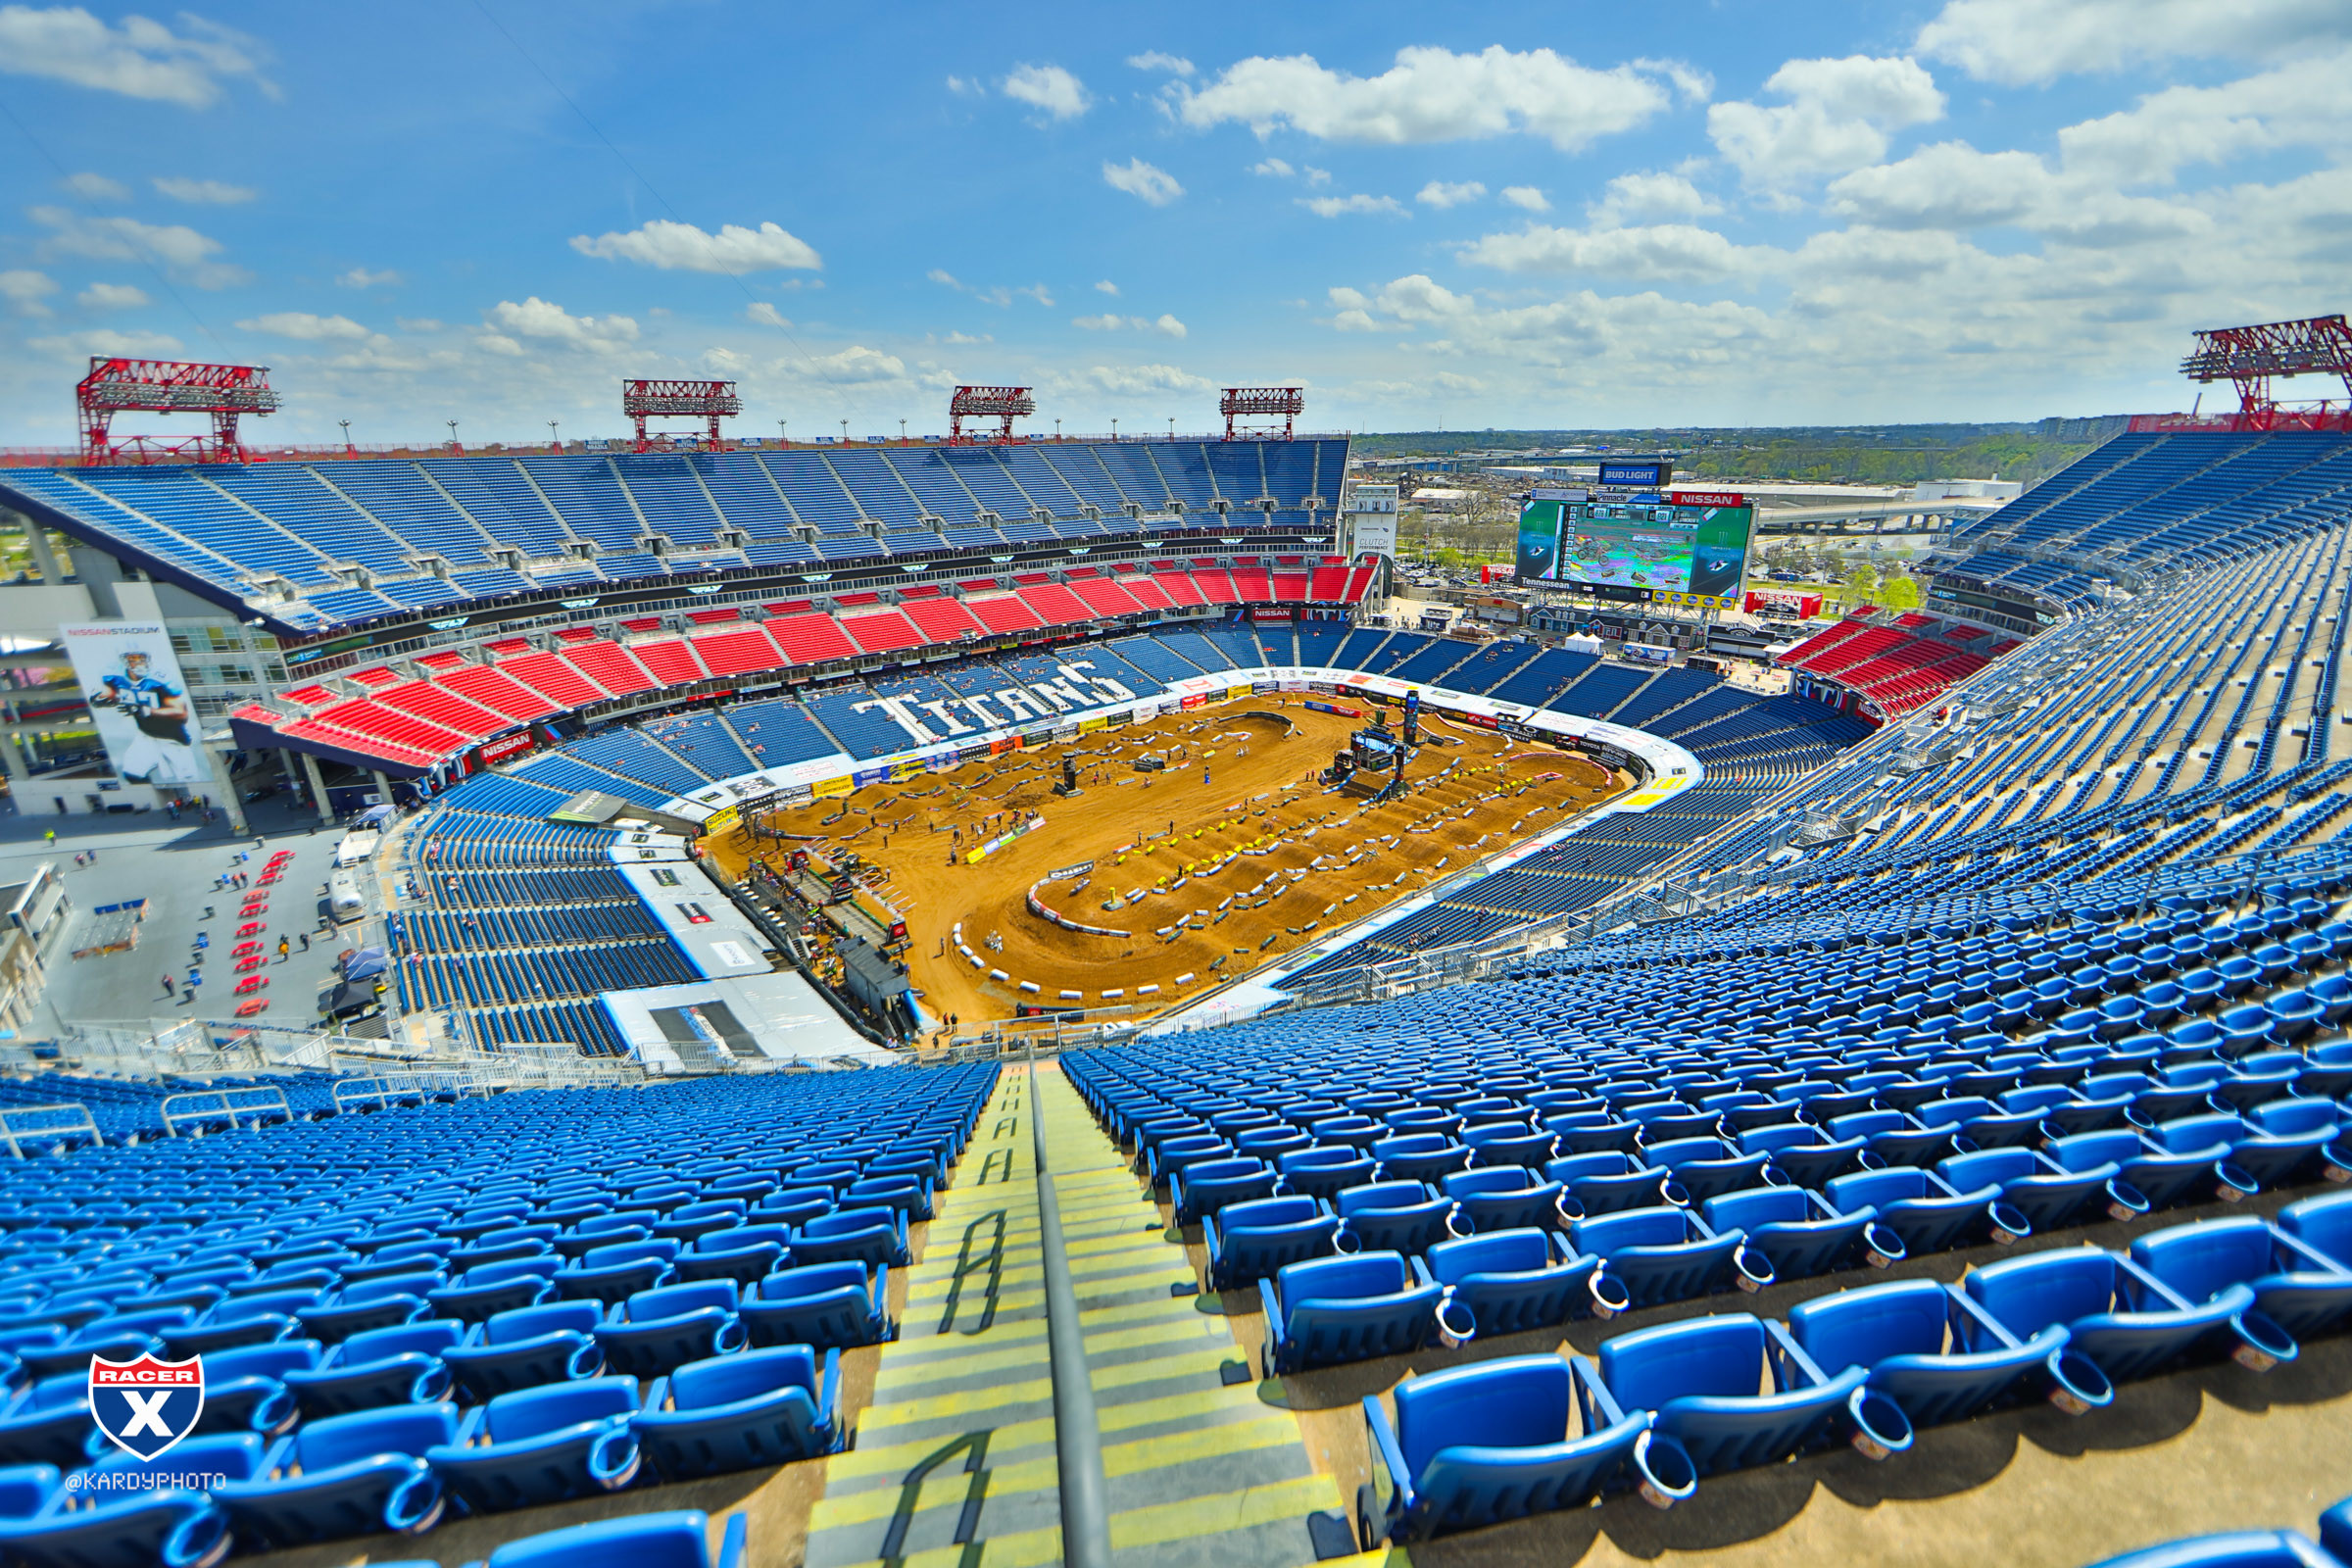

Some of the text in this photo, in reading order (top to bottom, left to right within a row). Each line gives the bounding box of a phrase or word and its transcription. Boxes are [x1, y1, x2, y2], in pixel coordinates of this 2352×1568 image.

[1604, 470, 1655, 480] BUD LIGHT
[1597, 493, 1627, 503] Pinnacle
[1681, 494, 1733, 505] NISSAN
[1754, 593, 1802, 605] NISSAN
[851, 660, 1137, 745] TITANS
[482, 734, 530, 759] NISSAN
[1365, 737, 1390, 753] FINISH
[1580, 740, 1600, 751] TOYOTA
[708, 808, 737, 825] SUZUKI
